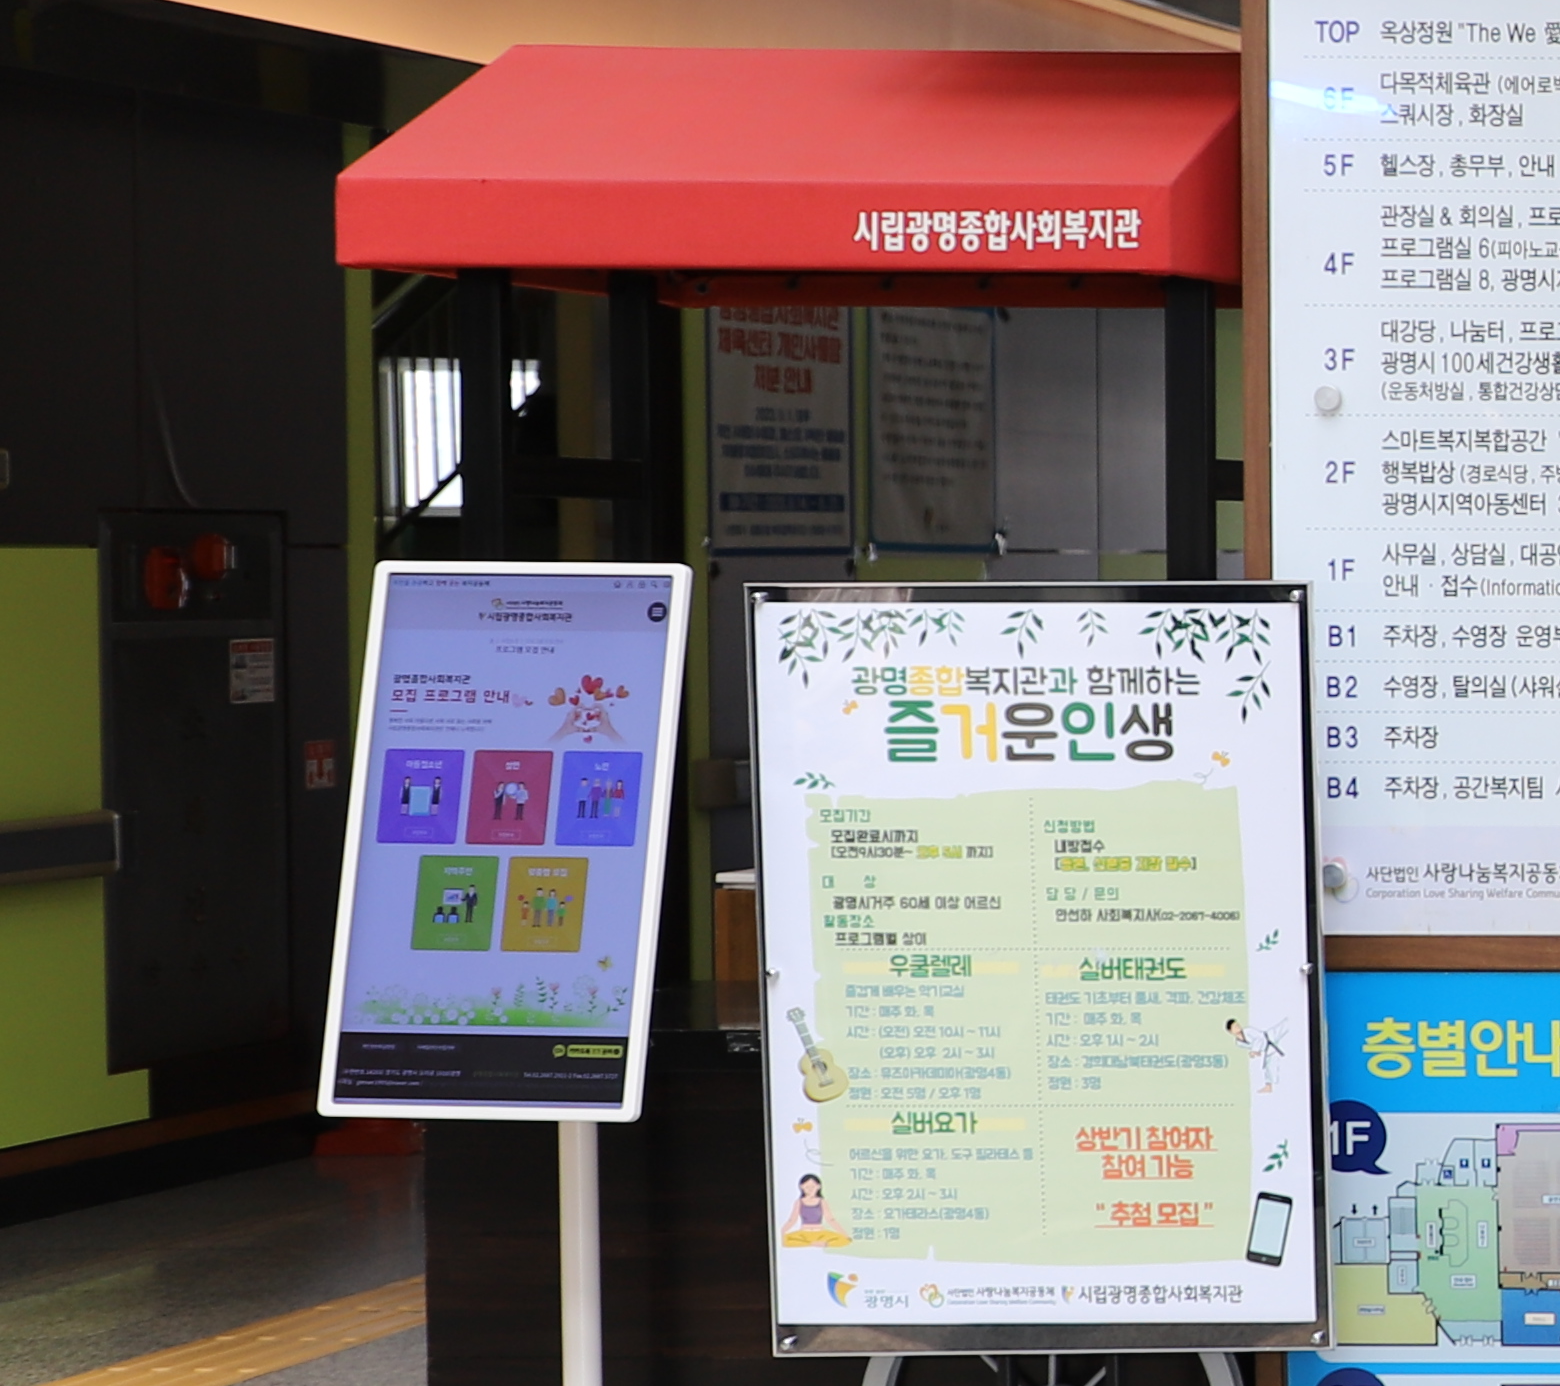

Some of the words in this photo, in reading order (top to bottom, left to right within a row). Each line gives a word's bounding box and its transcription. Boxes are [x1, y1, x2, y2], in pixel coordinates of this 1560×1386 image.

[1314, 19, 1360, 44] TOP
[1381, 20, 1453, 45] 옥상정원
[1457, 22, 1502, 44] "The
[1506, 23, 1536, 43] We
[852, 205, 1144, 254] 시립광명종합사회복지관
[1382, 428, 1547, 454] 스마트복지복합공간
[1325, 460, 1356, 484] 2F
[1328, 624, 1356, 648] B1
[1453, 625, 1507, 649] 수영장
[851, 664, 1078, 698] 광명종합복지관과
[1086, 664, 1201, 698] 함께하는
[391, 689, 418, 703] 모집
[424, 689, 477, 703] 프로그램
[483, 689, 510, 703] 안내
[1326, 725, 1358, 749] B3
[1384, 725, 1439, 750] 주차장
[1365, 863, 1419, 886] 사단법인
[935, 896, 960, 910] 이상
[964, 896, 1001, 910] 어르신
[1365, 884, 1422, 901] Corporation
[1423, 889, 1446, 899] Love
[1446, 885, 1485, 901] Sharing
[1485, 885, 1523, 902] Welfare
[888, 954, 973, 979] 우쿨렐레
[890, 1111, 979, 1136] 실버요가
[1075, 1126, 1141, 1151] 상반기
[1147, 1126, 1214, 1151] 참여자
[1101, 1154, 1145, 1179] 참여
[1150, 1154, 1194, 1179] 가능
[1077, 1284, 1244, 1305] 시립광명종합사회복지관
